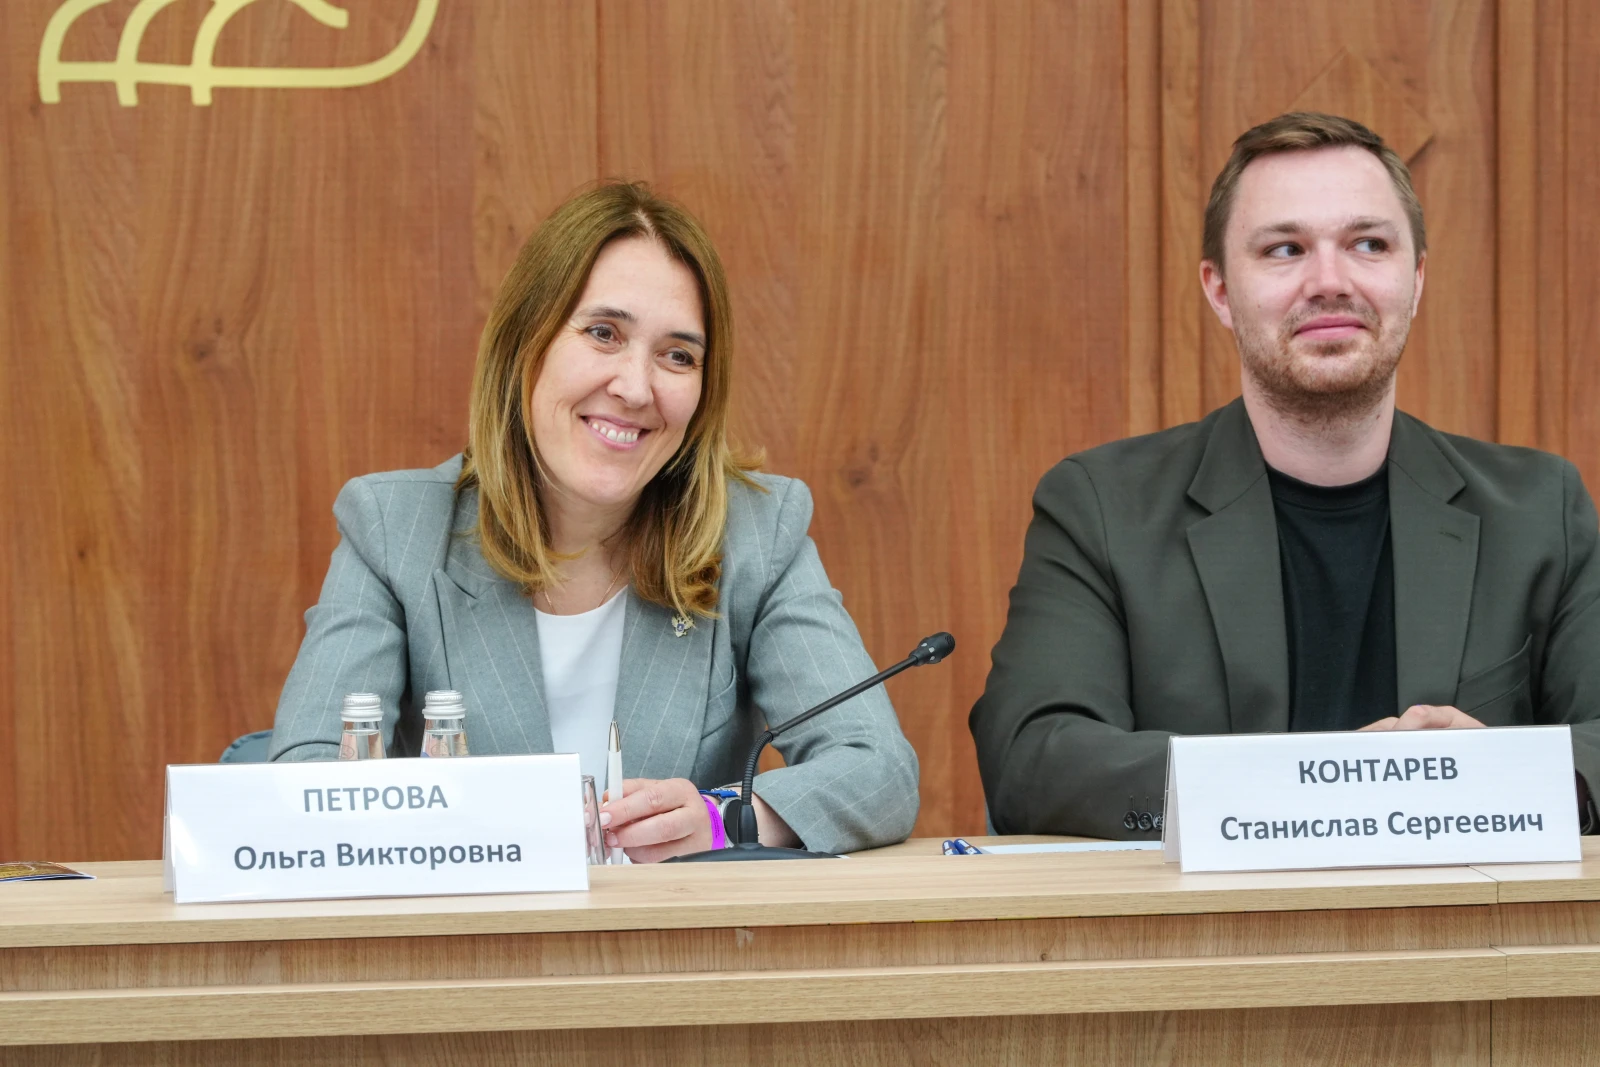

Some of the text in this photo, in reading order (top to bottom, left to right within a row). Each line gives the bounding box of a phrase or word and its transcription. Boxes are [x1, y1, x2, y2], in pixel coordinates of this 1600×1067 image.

[1298, 757, 1459, 784] КОНТАРЕВ
[304, 784, 448, 813] ПЕТРОВА
[1220, 811, 1544, 841] Станислав Сергеевич
[234, 844, 523, 870] Ольга Викторовна
